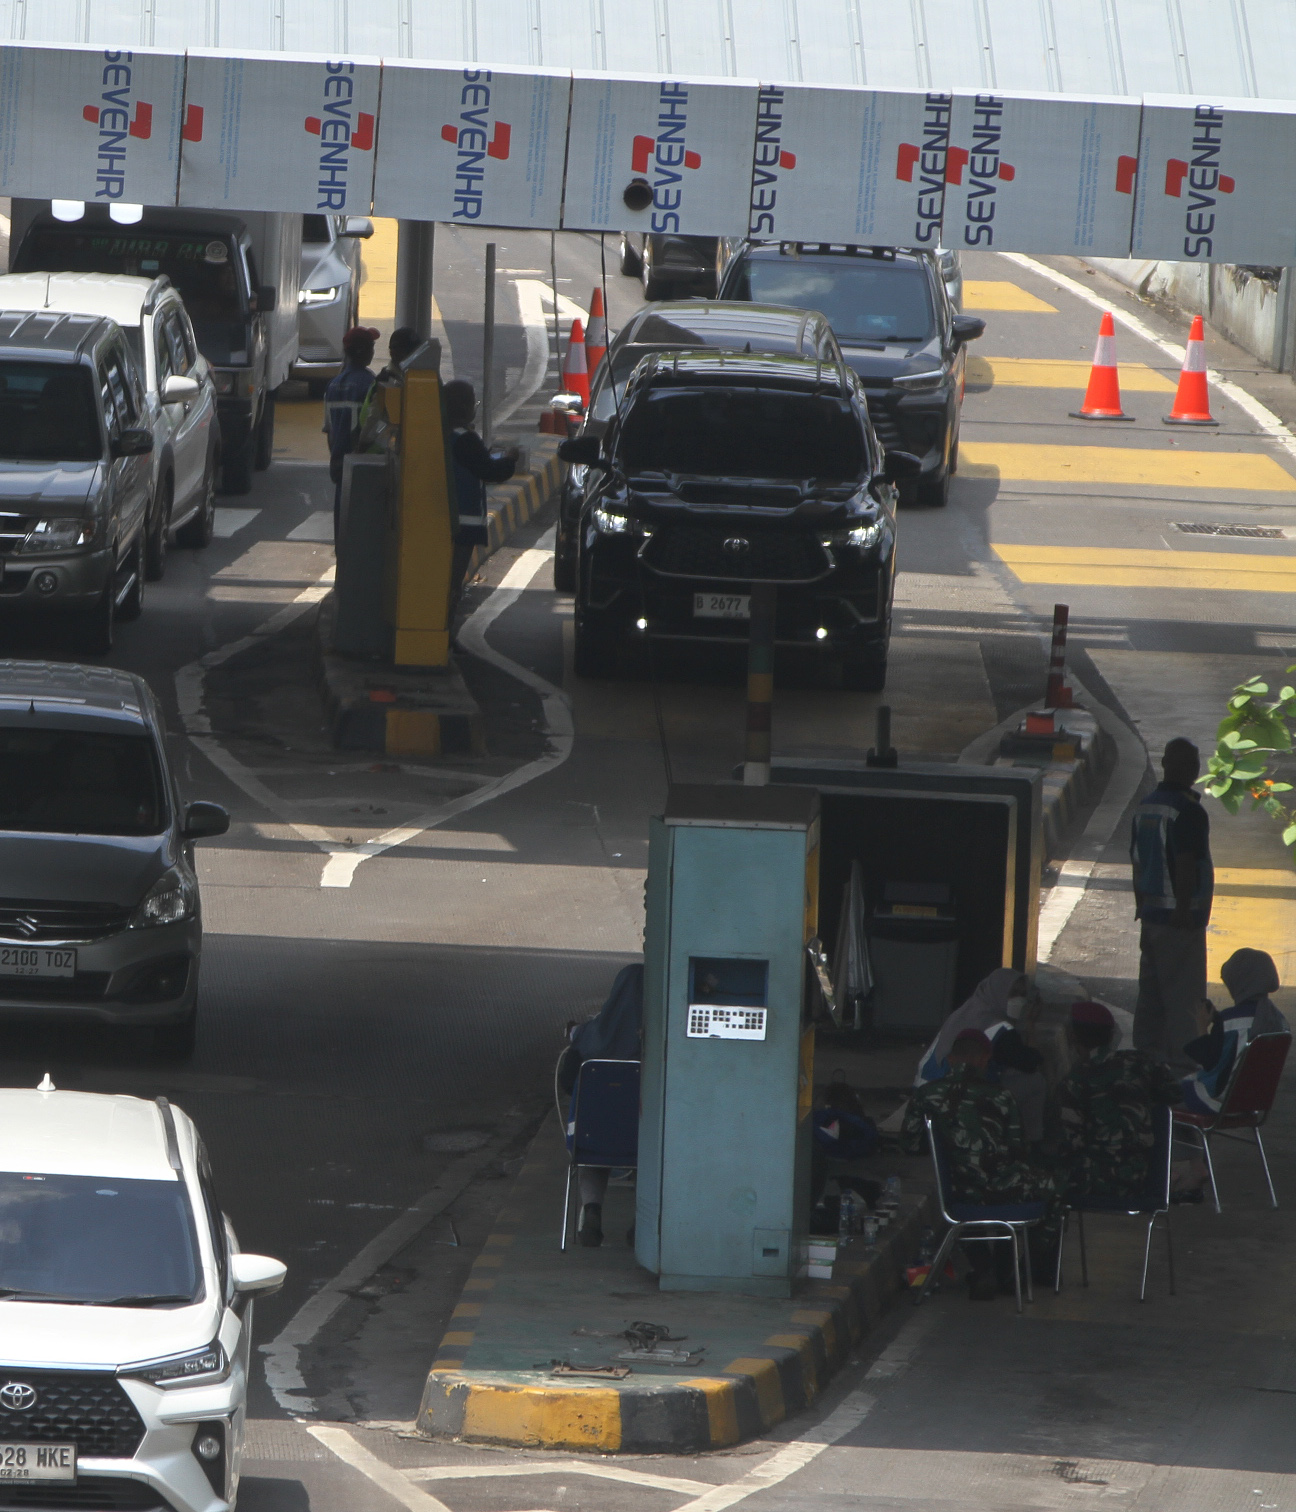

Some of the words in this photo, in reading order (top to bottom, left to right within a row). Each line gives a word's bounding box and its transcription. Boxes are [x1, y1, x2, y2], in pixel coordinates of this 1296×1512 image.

[95, 48, 132, 199] SEVENHR
[316, 60, 354, 211] SEVENHR
[452, 67, 491, 219] SEVENHR
[696, 596, 704, 609] B
[710, 596, 742, 611] 2677
[1, 949, 39, 966] 2100
